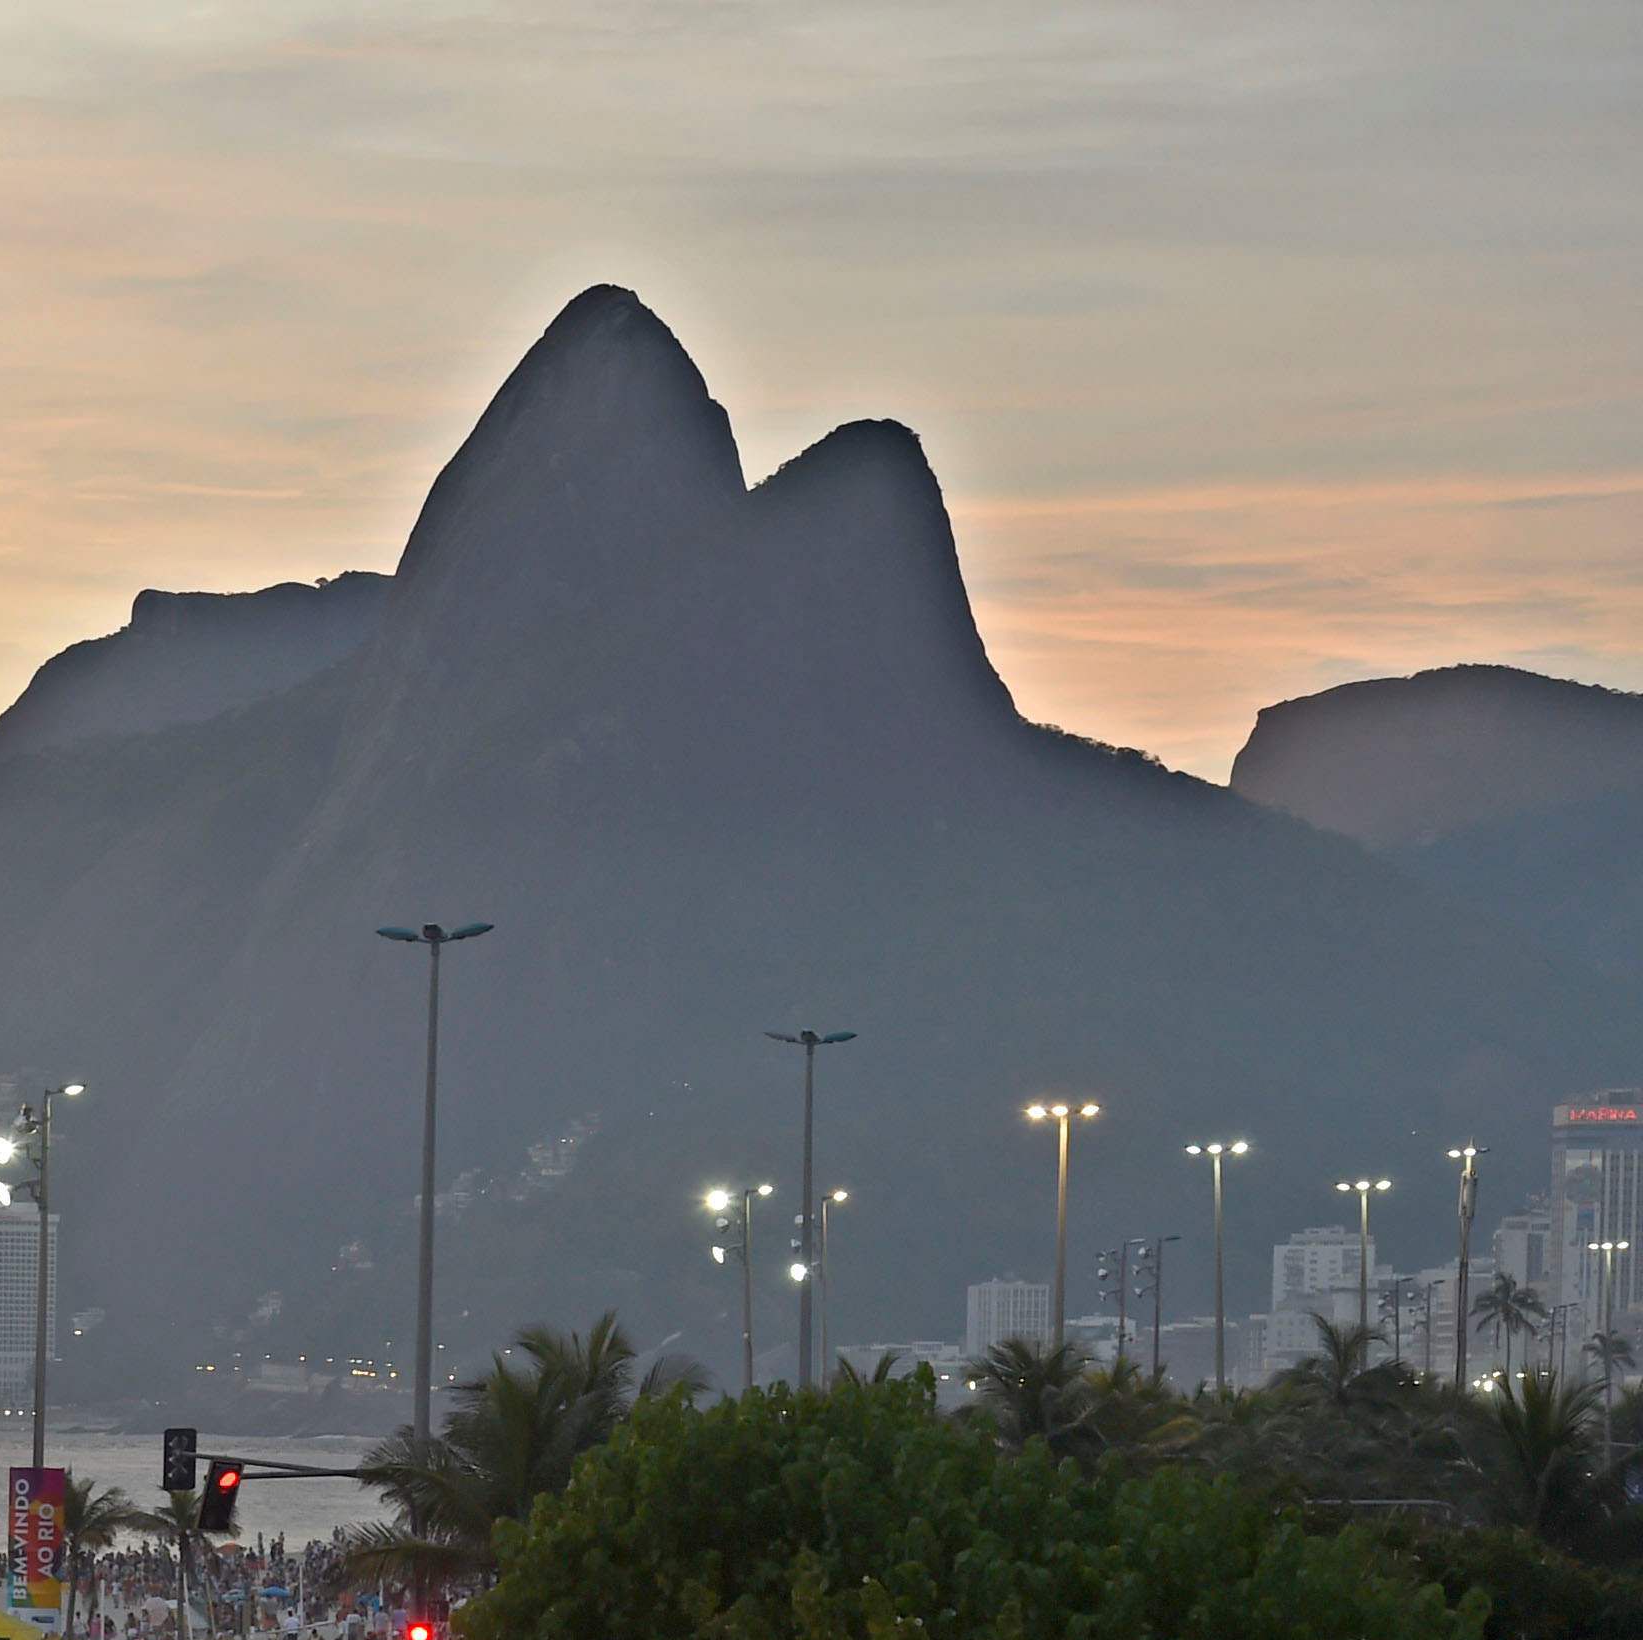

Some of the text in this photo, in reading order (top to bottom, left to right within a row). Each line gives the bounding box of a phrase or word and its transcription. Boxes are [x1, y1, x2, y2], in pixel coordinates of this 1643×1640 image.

[13, 1479, 30, 1600] BEM-VINDO
[38, 1504, 55, 1578] AO RIO
